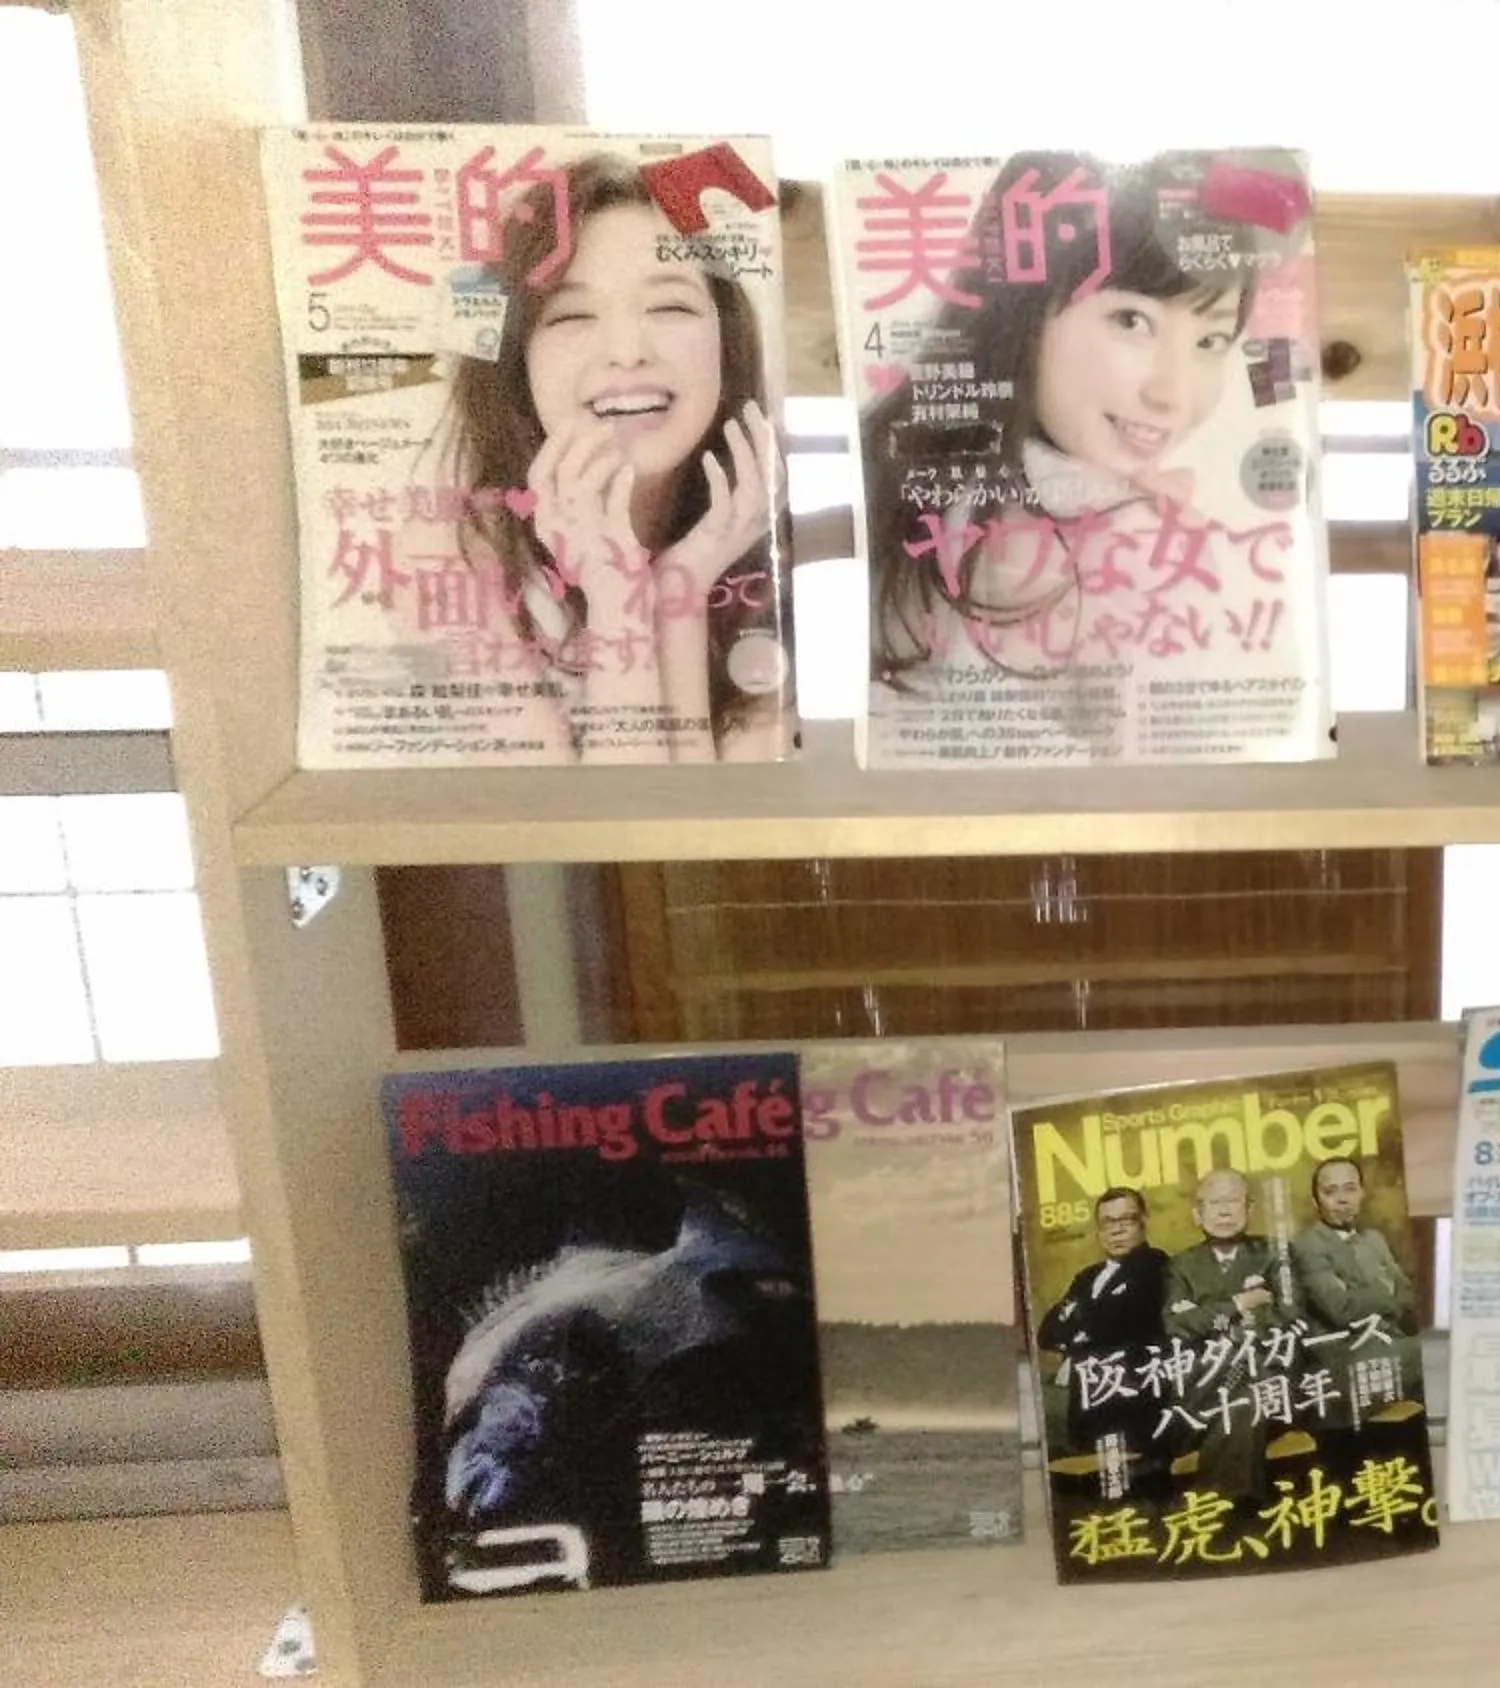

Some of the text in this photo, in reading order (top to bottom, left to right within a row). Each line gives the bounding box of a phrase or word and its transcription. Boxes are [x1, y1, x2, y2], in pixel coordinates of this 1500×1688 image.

[302, 145, 572, 287] 美的
[857, 168, 1112, 310] 美的
[307, 293, 332, 332] 5
[864, 322, 886, 358] 4
[1428, 459, 1487, 483] るるぶ
[1428, 510, 1483, 528] プラン
[399, 1078, 794, 1160] Fishing Café
[853, 1067, 996, 1126] Café
[1033, 1092, 1391, 1202] Number
[1474, 1141, 1494, 1165] 8
[1039, 1201, 1090, 1229] 885
[1075, 1312, 1392, 1409] 阪神タイガース
[1152, 1368, 1341, 1441] 八十周年
[1069, 1455, 1438, 1566] 猛虎、神撃。
